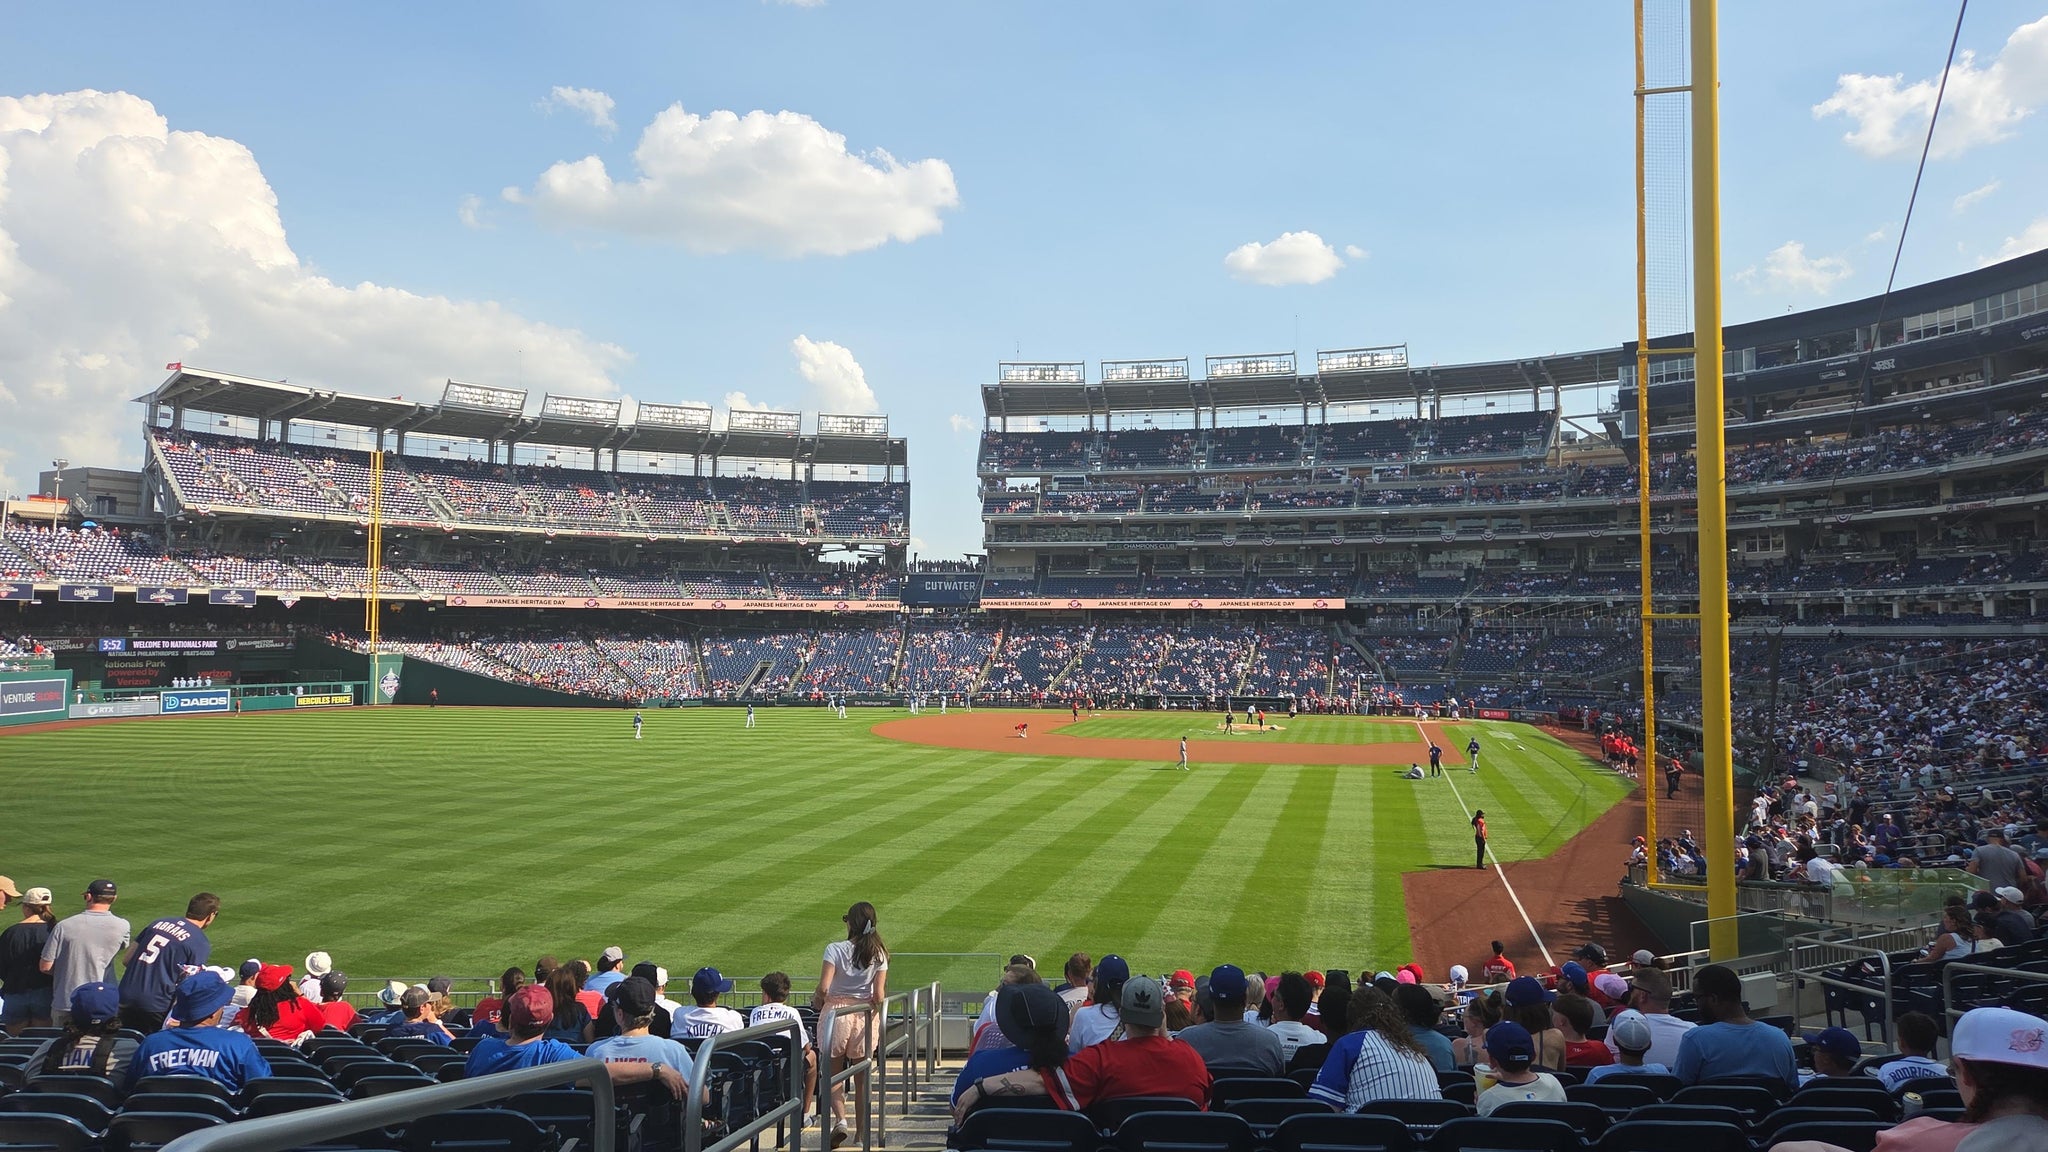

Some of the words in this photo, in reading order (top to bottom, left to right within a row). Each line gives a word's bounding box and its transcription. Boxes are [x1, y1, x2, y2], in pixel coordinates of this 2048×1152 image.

[925, 581, 976, 591] CUTWATER
[102, 640, 122, 650] 3:52
[133, 640, 161, 649] WELCOME
[162, 640, 170, 649] TO
[170, 640, 202, 649] NATIONALS
[202, 640, 218, 648] PARK
[145, 659, 166, 668] Park
[107, 669, 147, 677] powered
[148, 668, 159, 676] by
[197, 669, 232, 678] verizon
[117, 678, 150, 686] Verizon
[3, 691, 36, 704] VENTURE
[180, 697, 227, 707] DABOS
[297, 696, 331, 706] HERCULES
[331, 695, 352, 704] FENCE
[153, 921, 191, 942] ABRAMS
[138, 934, 170, 964] 5
[150, 1048, 219, 1072] FREEMAN
